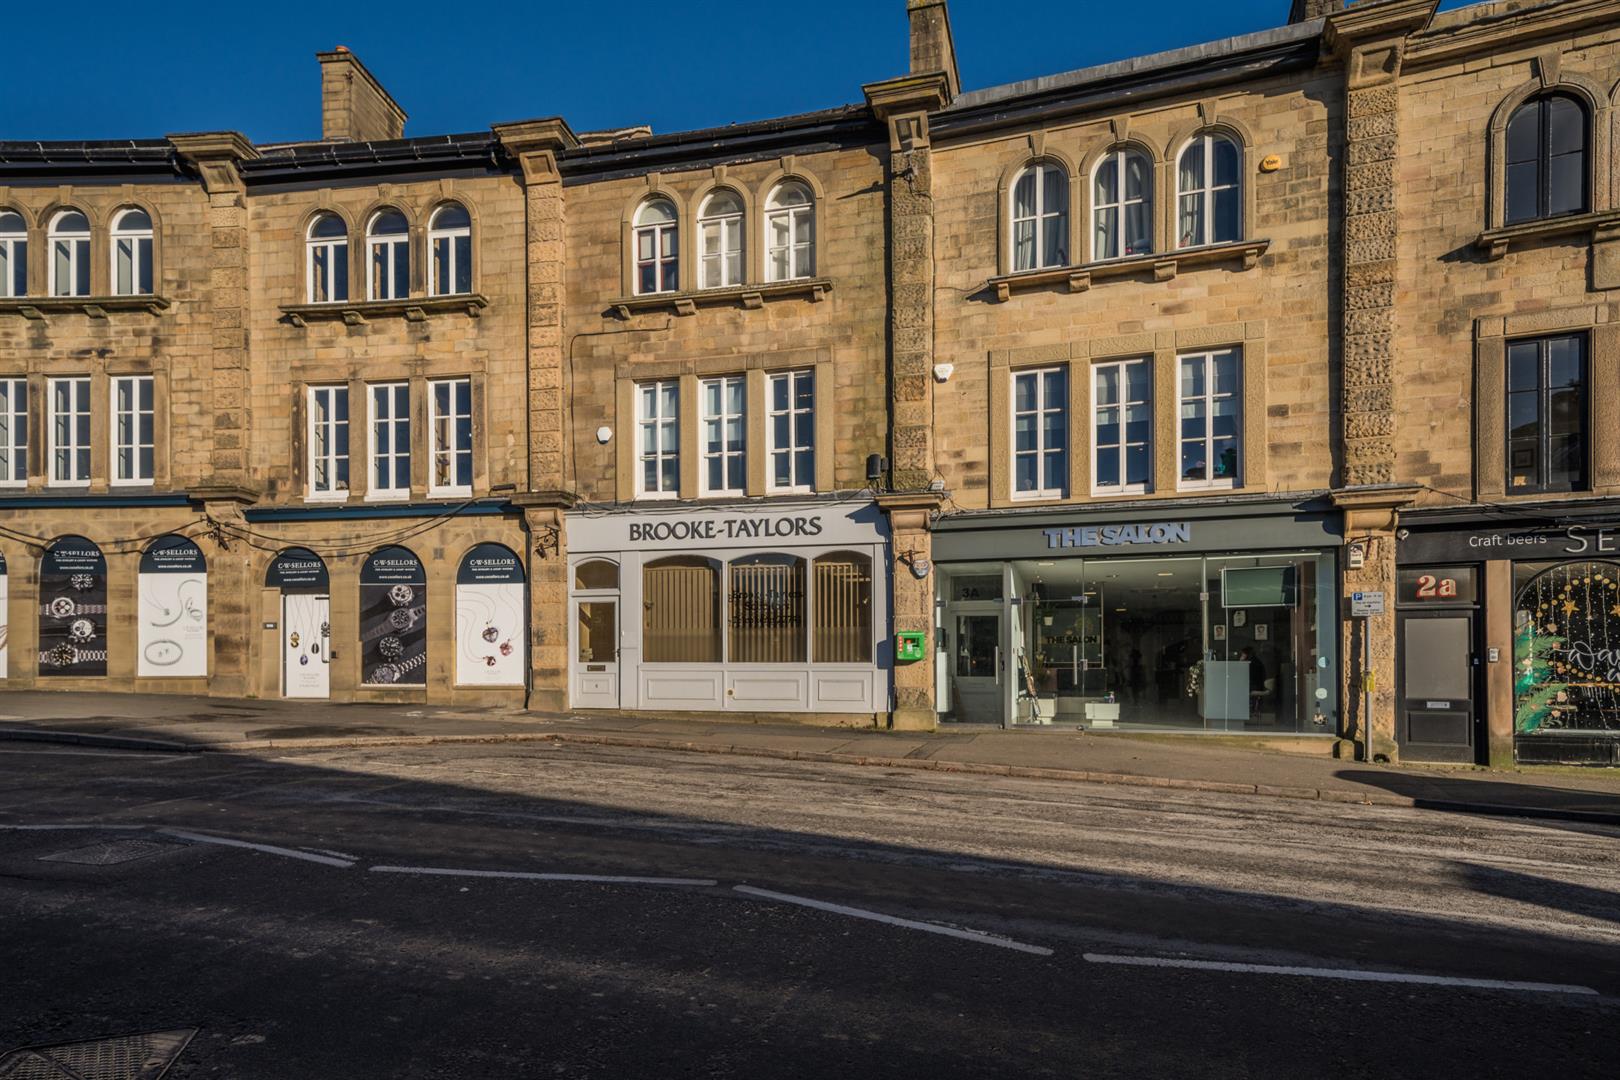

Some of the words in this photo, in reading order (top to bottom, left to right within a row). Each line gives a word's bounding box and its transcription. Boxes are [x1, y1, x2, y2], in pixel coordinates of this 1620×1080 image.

[629, 516, 822, 541] BROOKE-TAYLORS
[1043, 527, 1098, 549] THE
[1100, 521, 1191, 545] SALON
[1469, 534, 1502, 547] Craft
[1507, 533, 1547, 545] beers
[962, 588, 980, 598] 3A
[1416, 575, 1457, 598] 2a
[1046, 636, 1065, 644] THE
[1066, 635, 1098, 643] SALON
